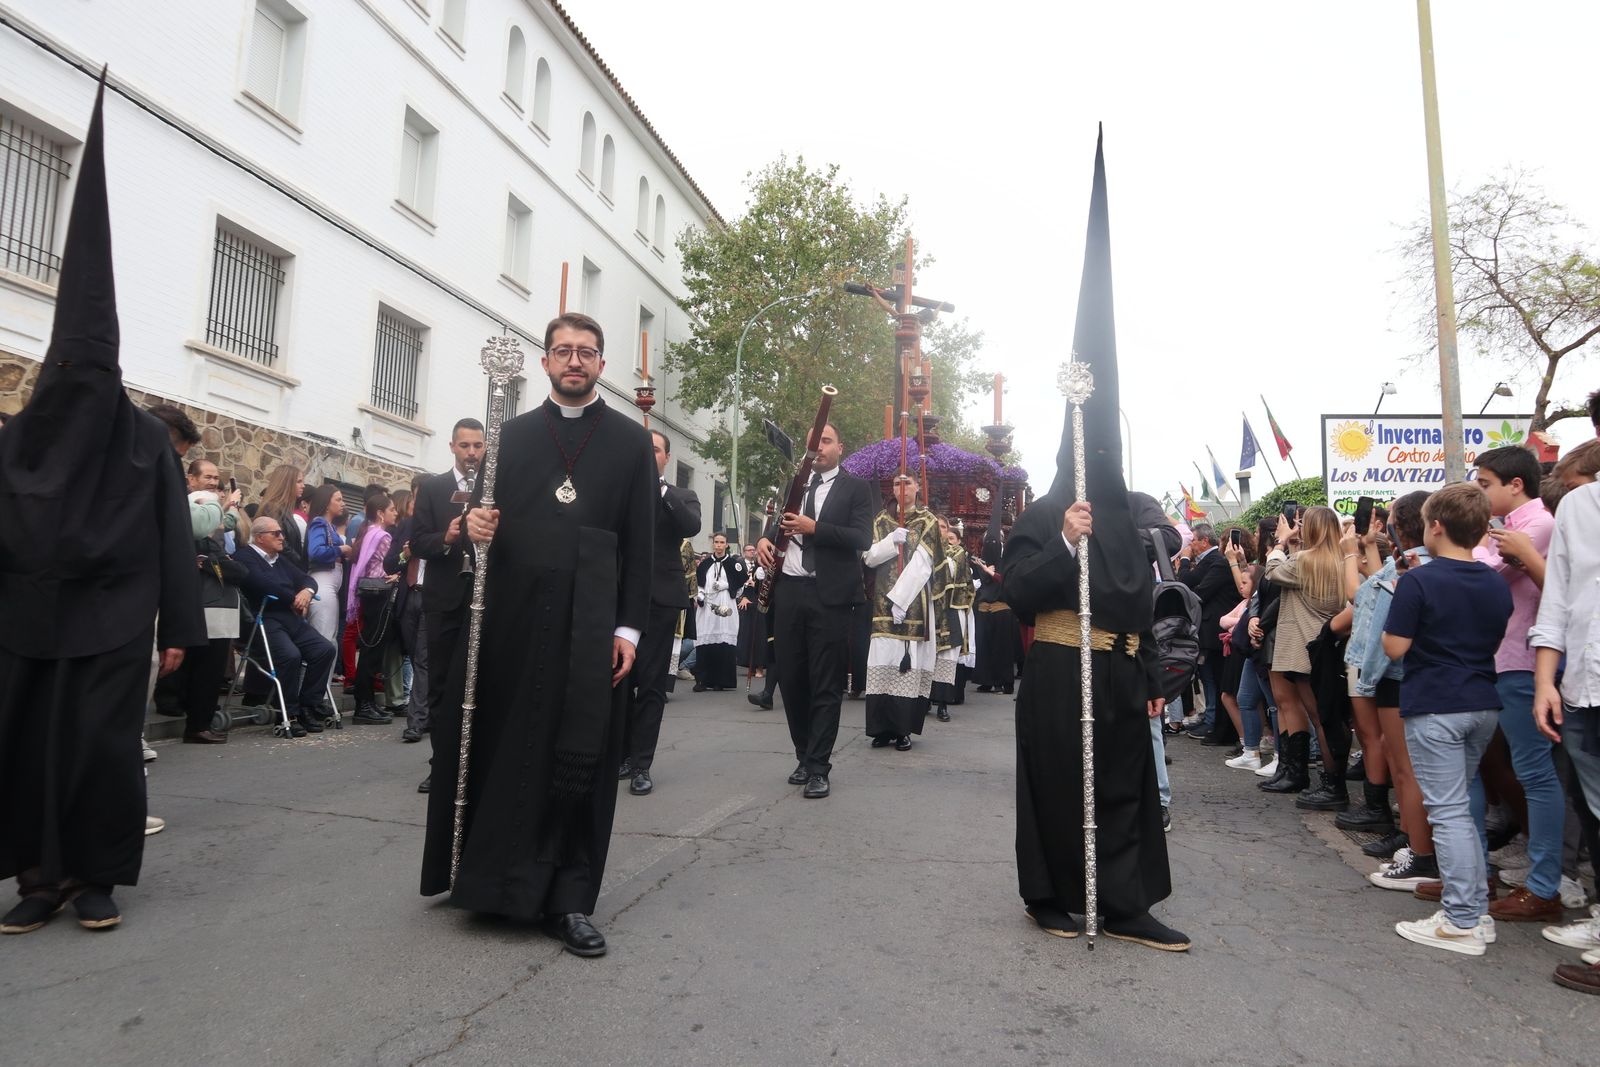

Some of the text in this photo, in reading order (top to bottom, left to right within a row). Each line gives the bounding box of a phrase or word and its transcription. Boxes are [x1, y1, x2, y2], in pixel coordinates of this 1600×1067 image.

[1364, 420, 1375, 435] el
[1377, 424, 1484, 445] Invernaro
[1387, 446, 1430, 464] Centro
[1432, 447, 1446, 462] de
[1330, 468, 1358, 482] Los
